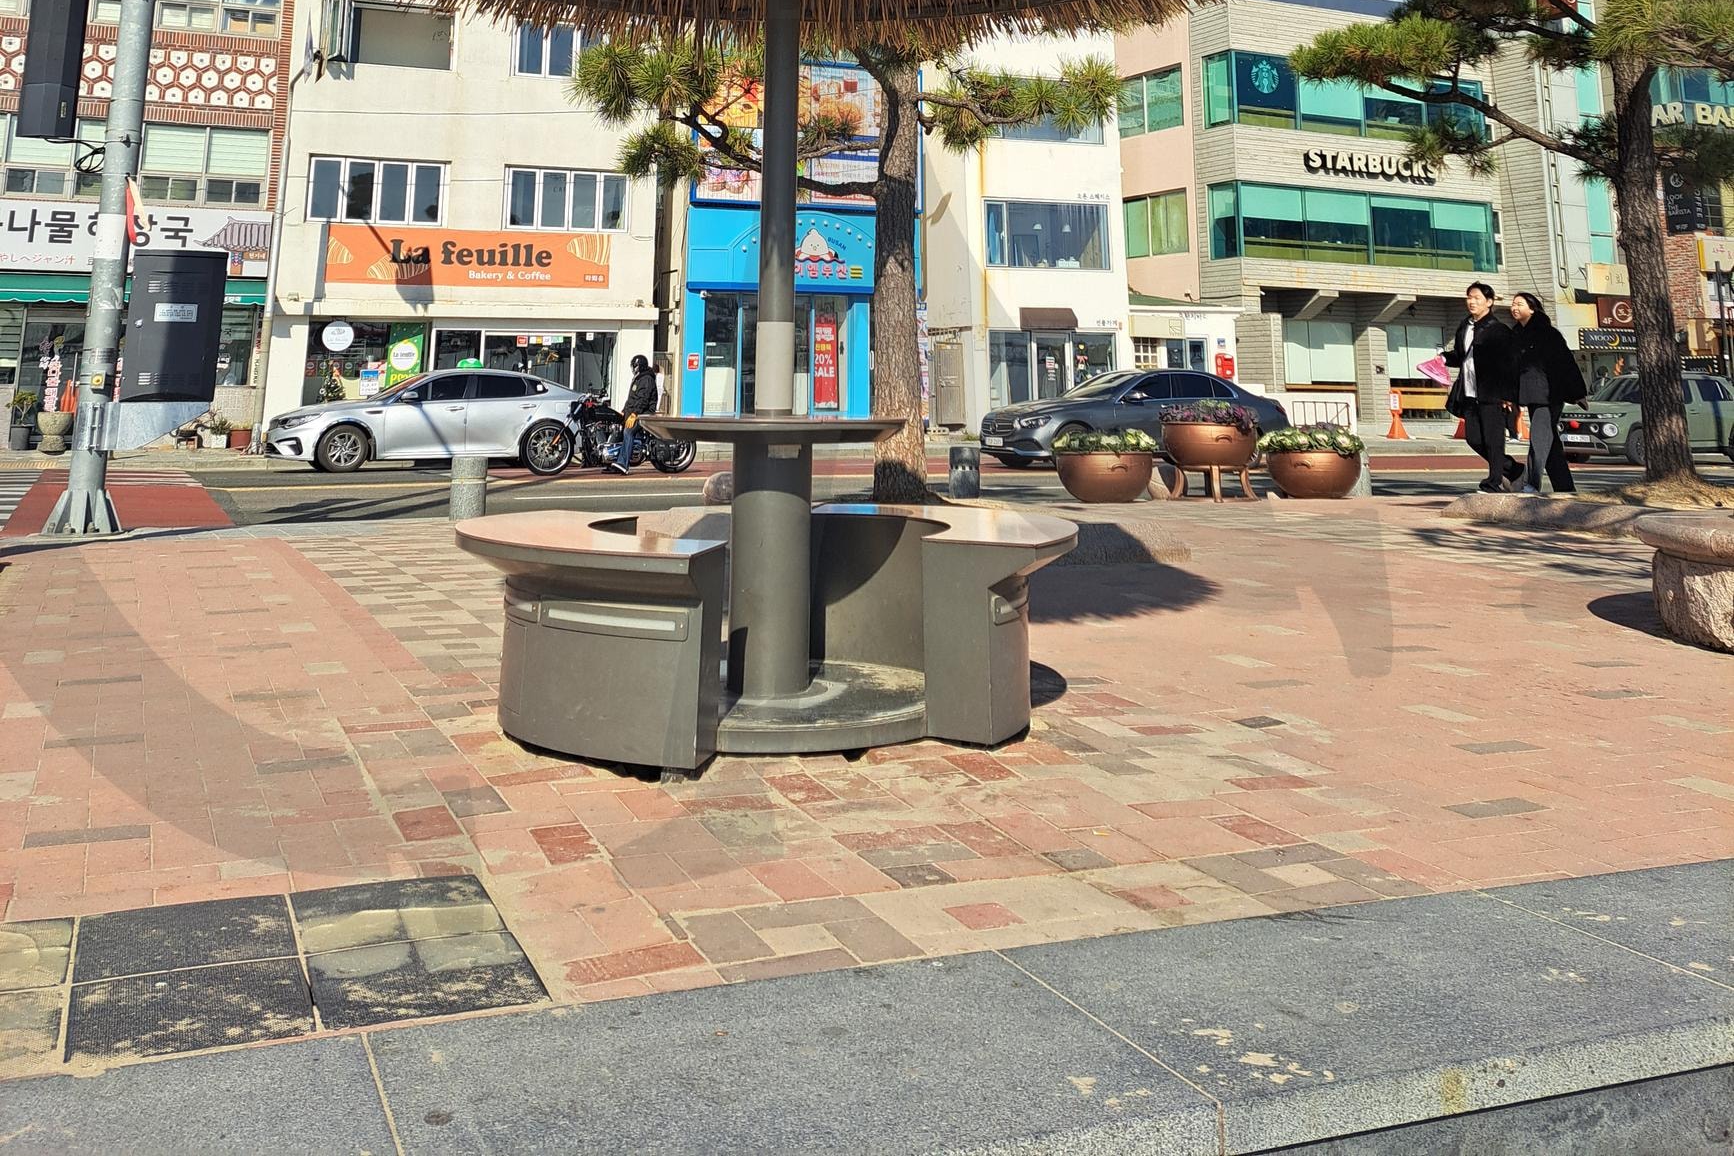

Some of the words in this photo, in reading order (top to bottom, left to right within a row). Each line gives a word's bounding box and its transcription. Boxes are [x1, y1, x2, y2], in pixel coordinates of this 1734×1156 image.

[1695, 102, 1734, 129] BA
[1307, 148, 1440, 180] STARBUCKS
[0, 208, 194, 248] 나물장국
[389, 239, 431, 264] La
[441, 241, 553, 267] feuille
[468, 270, 502, 281] Bakery
[506, 271, 515, 280] &
[518, 271, 551, 281] Coffee
[1589, 334, 1616, 342] MOON
[815, 353, 833, 365] 20%
